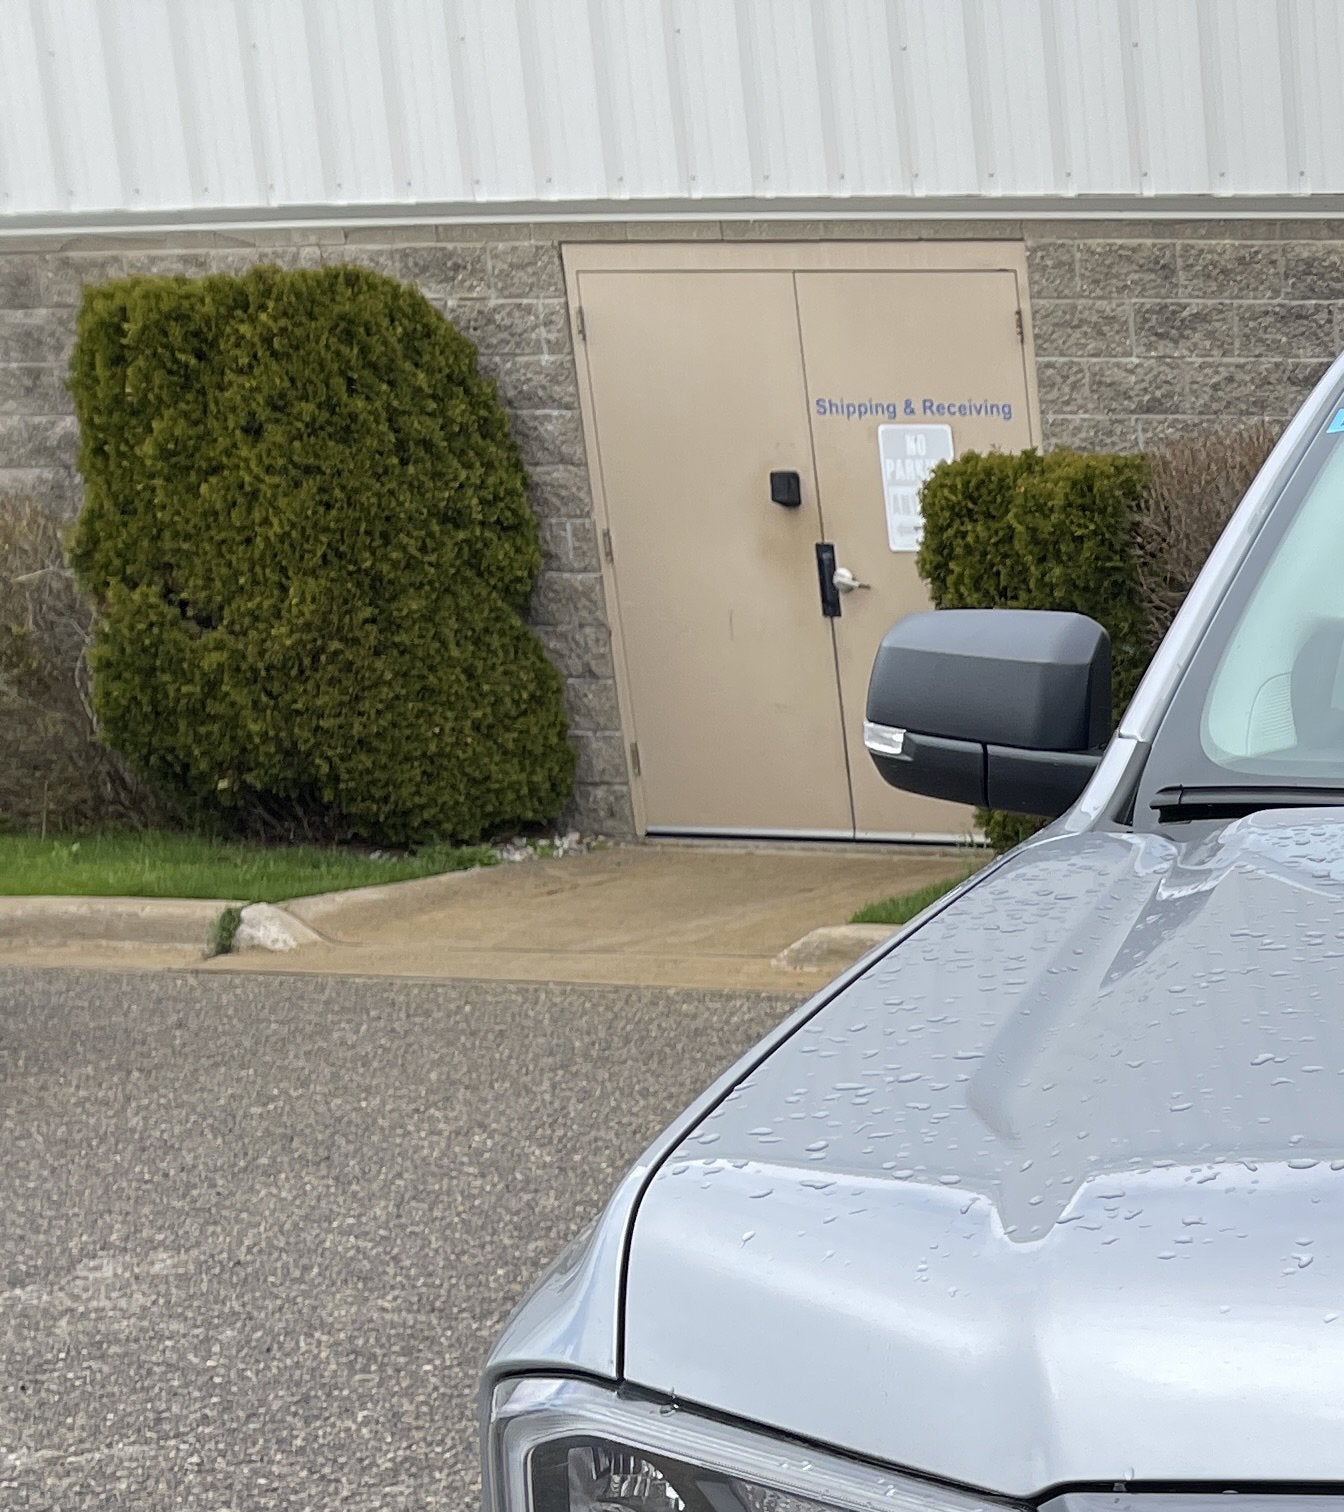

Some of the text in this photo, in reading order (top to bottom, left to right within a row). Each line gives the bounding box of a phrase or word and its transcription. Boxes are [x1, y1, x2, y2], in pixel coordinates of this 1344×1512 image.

[815, 398, 1012, 420] Shipping & Receiving
[905, 433, 927, 456] NO
